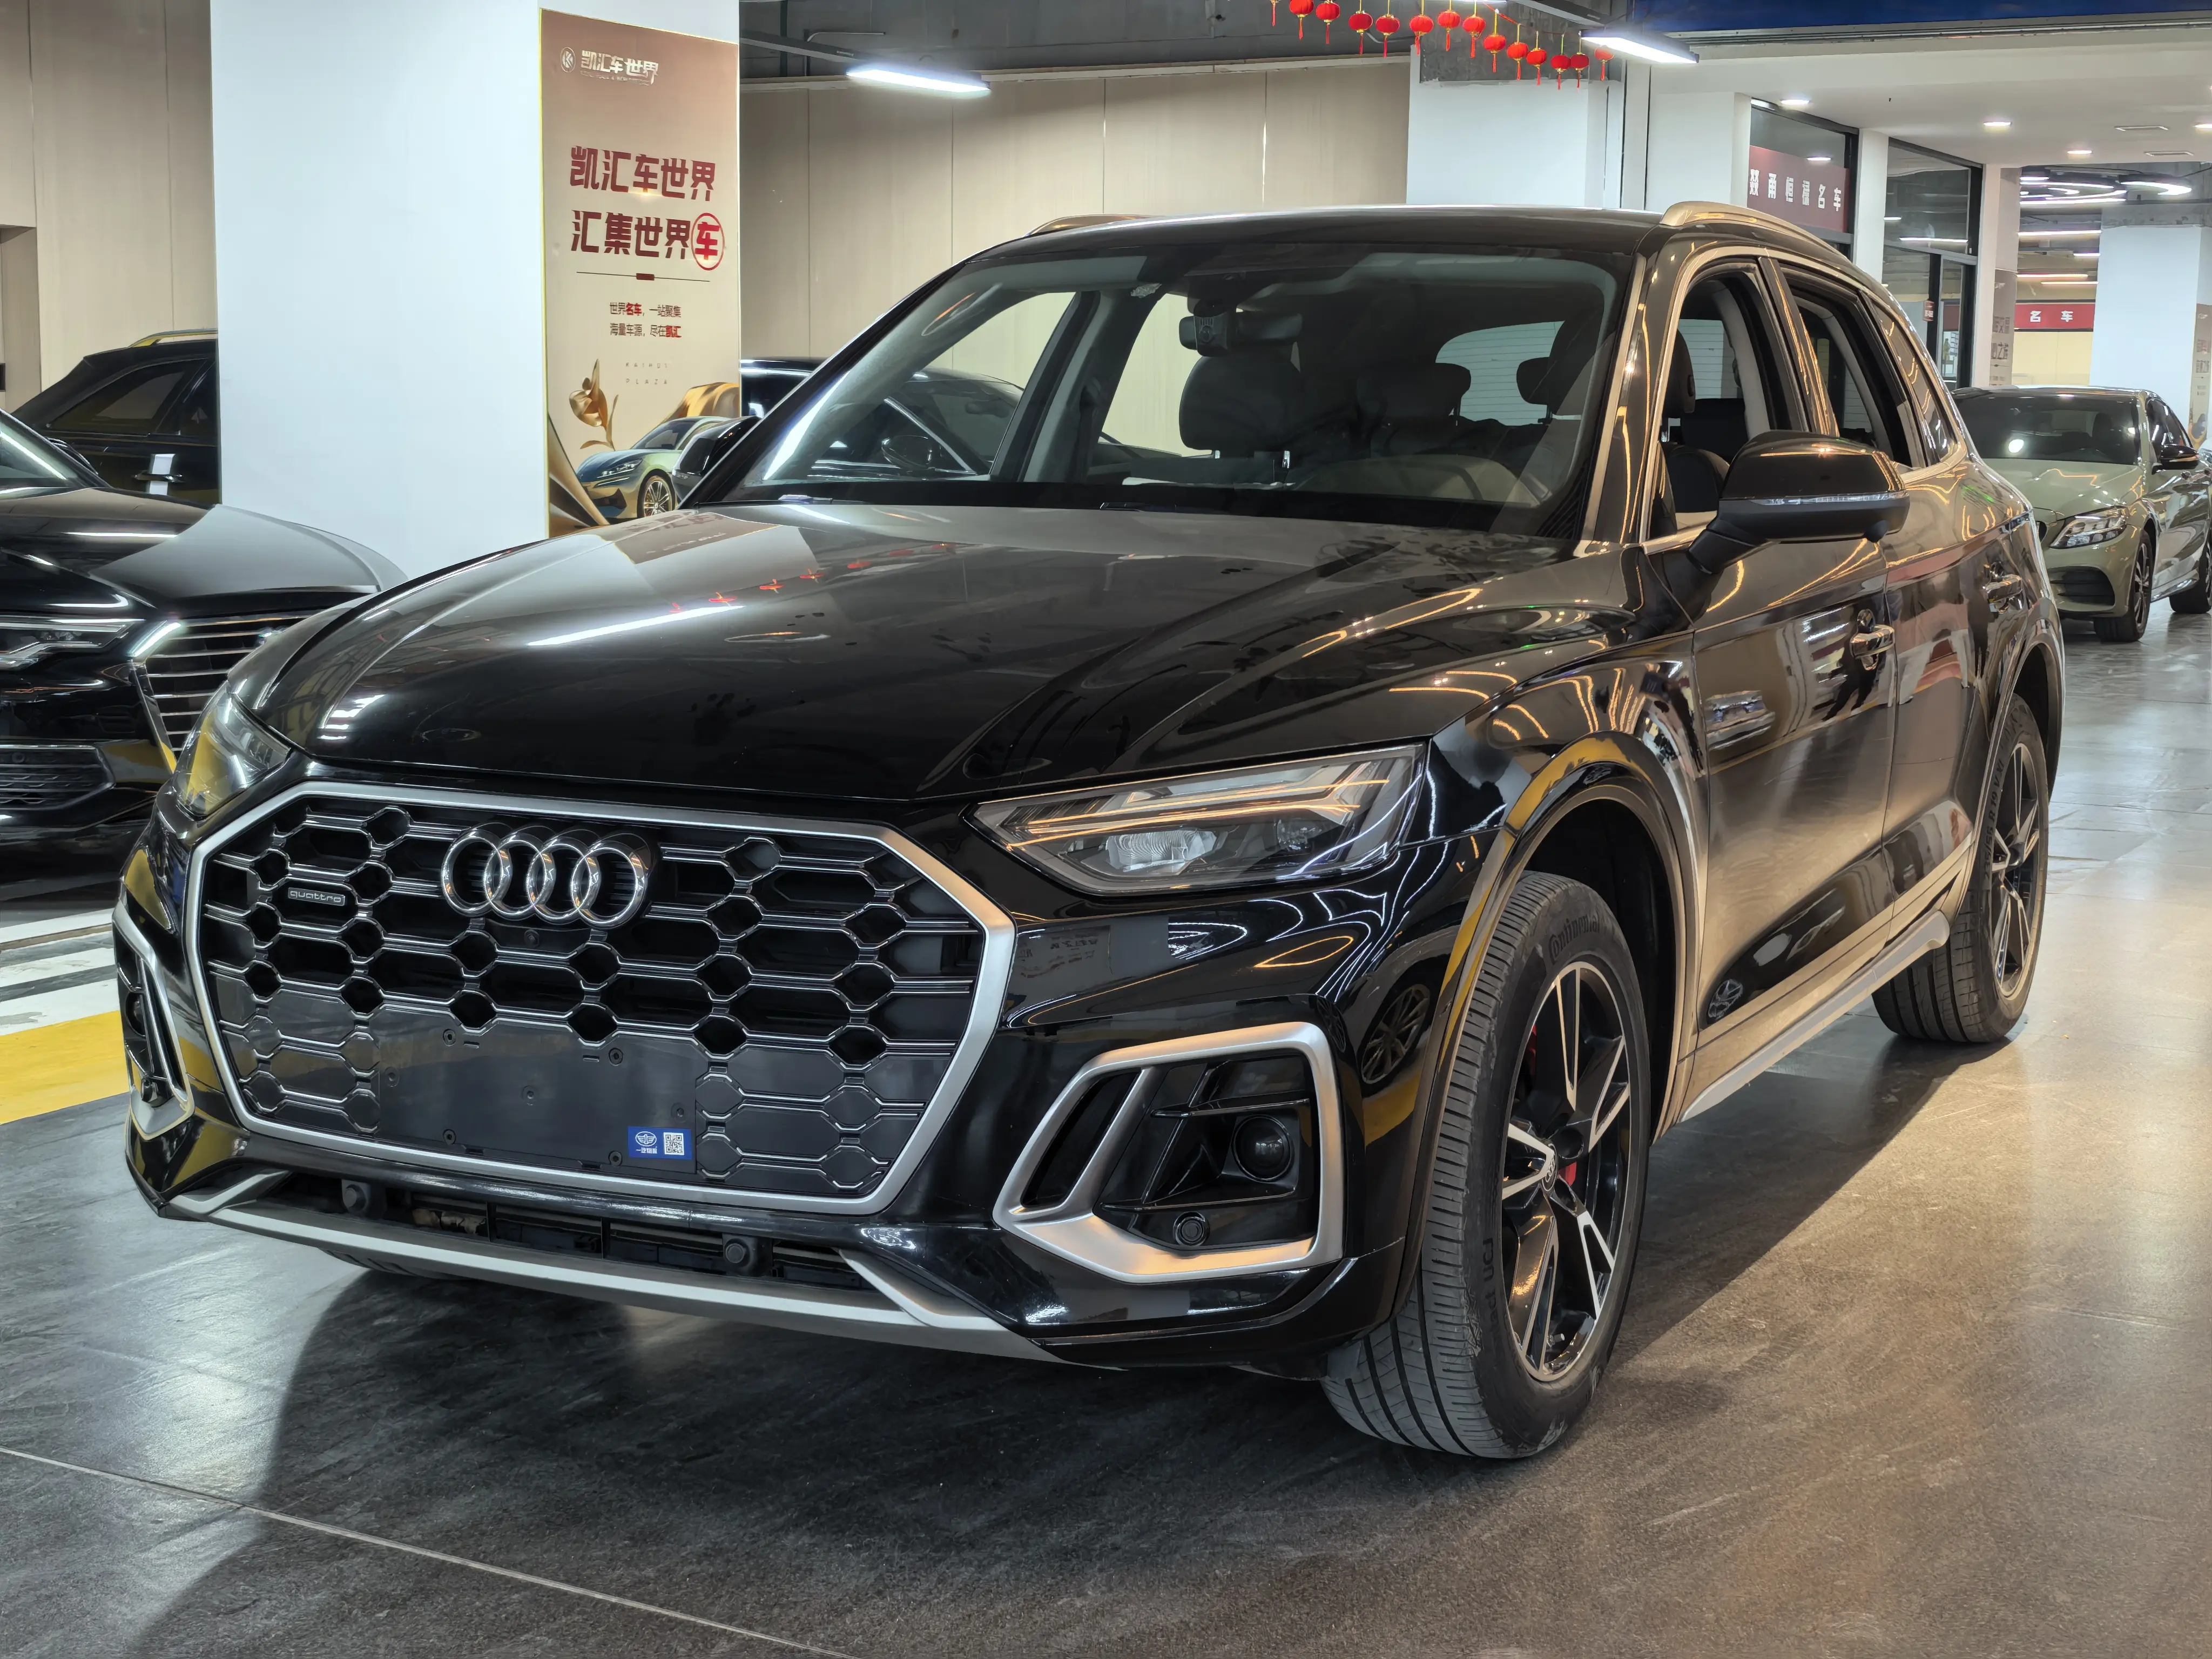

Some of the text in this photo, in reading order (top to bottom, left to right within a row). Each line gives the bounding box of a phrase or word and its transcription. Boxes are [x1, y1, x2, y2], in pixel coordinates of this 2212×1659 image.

[581, 50, 659, 76] 凯汇车世界
[570, 146, 716, 201] 凯汇车世界
[571, 210, 720, 262] 汇集世界车
[2030, 311, 2073, 322] 名车
[1991, 791, 1999, 806] 19
[290, 891, 341, 903] quattro
